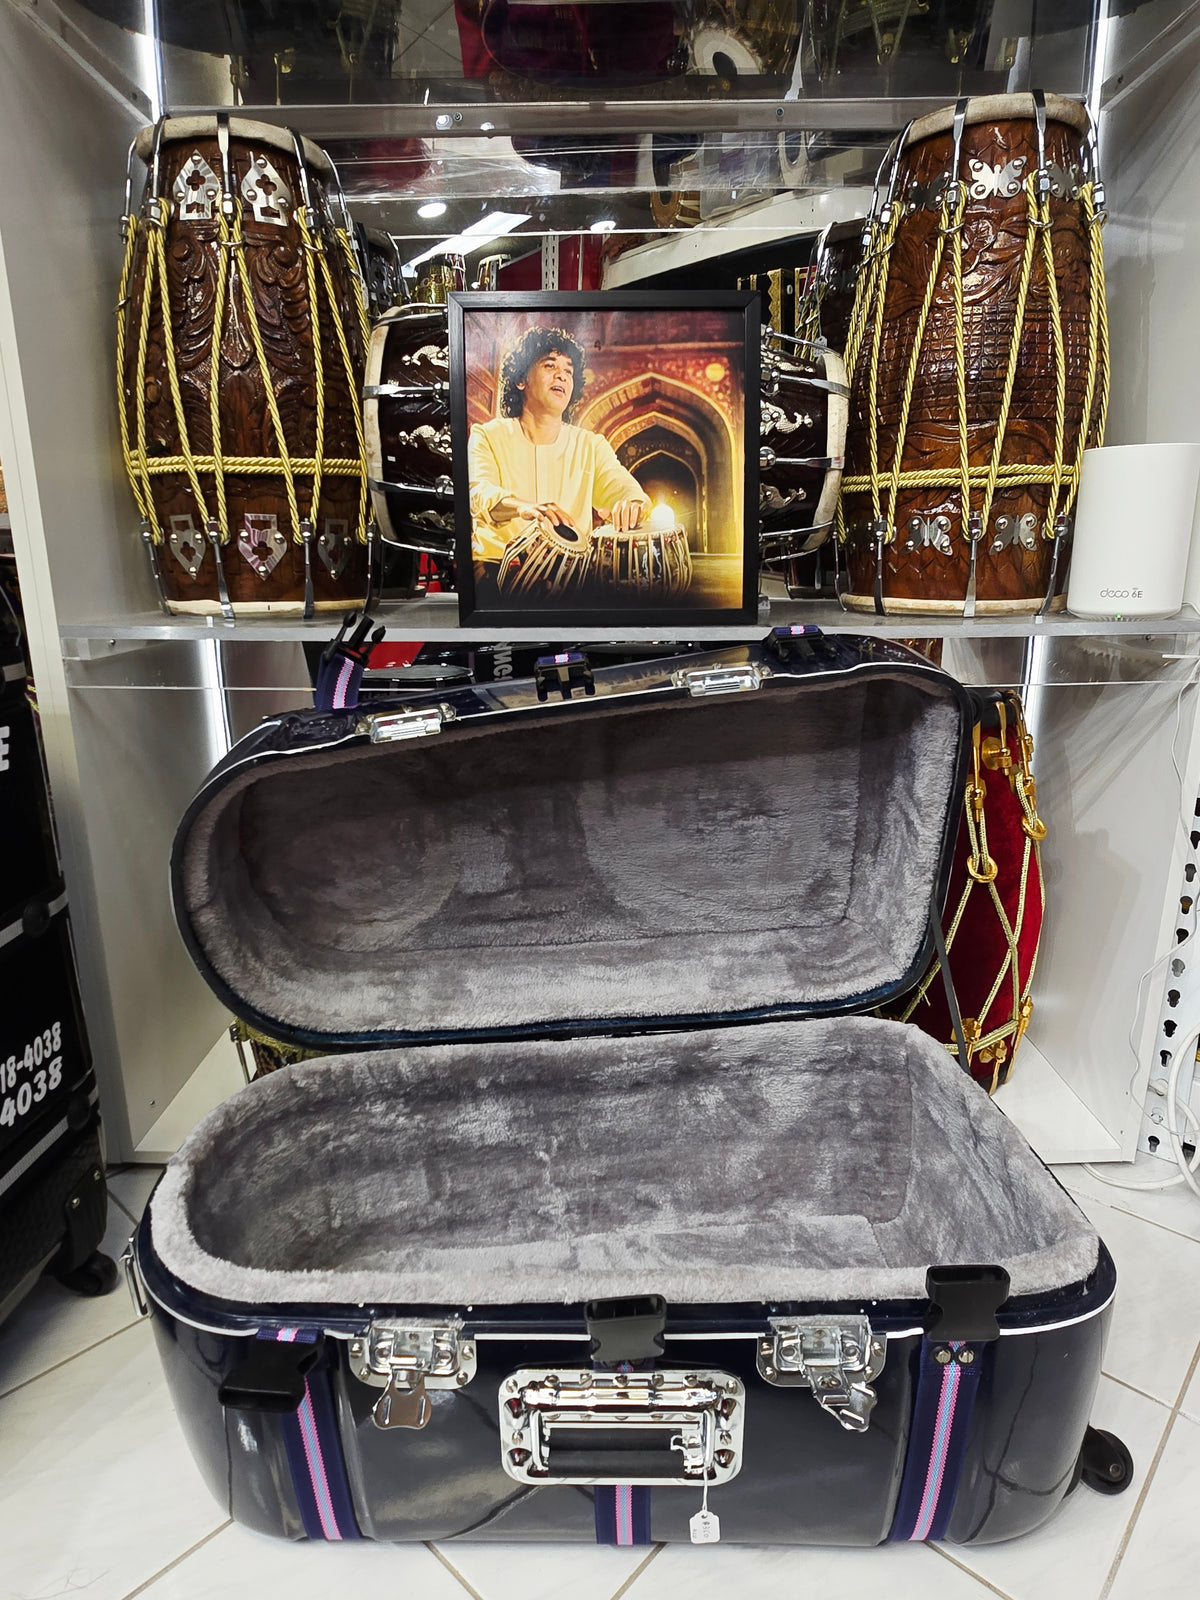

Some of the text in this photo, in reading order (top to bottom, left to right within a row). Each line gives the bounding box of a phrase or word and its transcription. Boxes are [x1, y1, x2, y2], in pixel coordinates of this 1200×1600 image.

[1100, 588, 1143, 599] deco 6E
[0, 1055, 63, 1127] 4038
